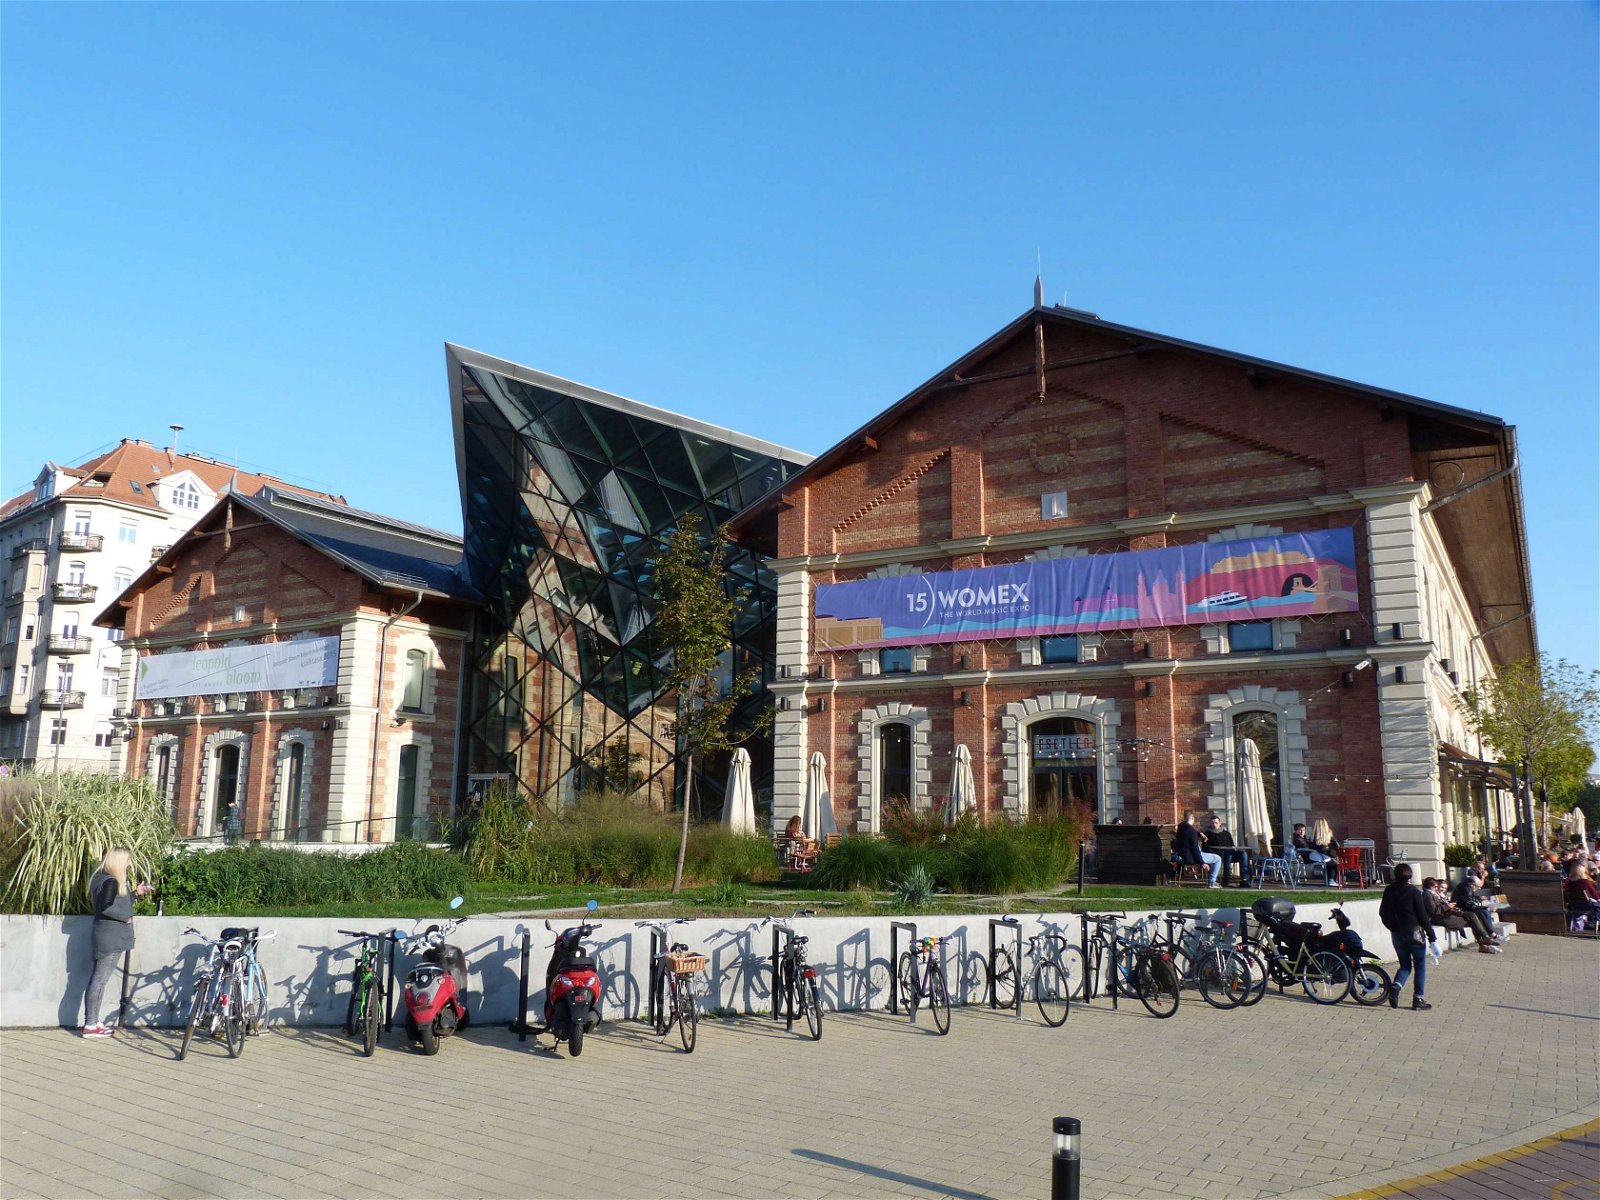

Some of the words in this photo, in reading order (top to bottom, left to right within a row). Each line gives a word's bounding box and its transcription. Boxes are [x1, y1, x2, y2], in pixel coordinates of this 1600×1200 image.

[906, 592, 928, 613] 15
[938, 583, 1030, 609] WOMEX
[940, 610, 954, 618] THE
[955, 609, 982, 617] WORLD
[984, 606, 1008, 614] MUSIC
[1010, 604, 1030, 613] EXPO
[192, 652, 232, 673] leopold
[226, 668, 261, 686] bloom
